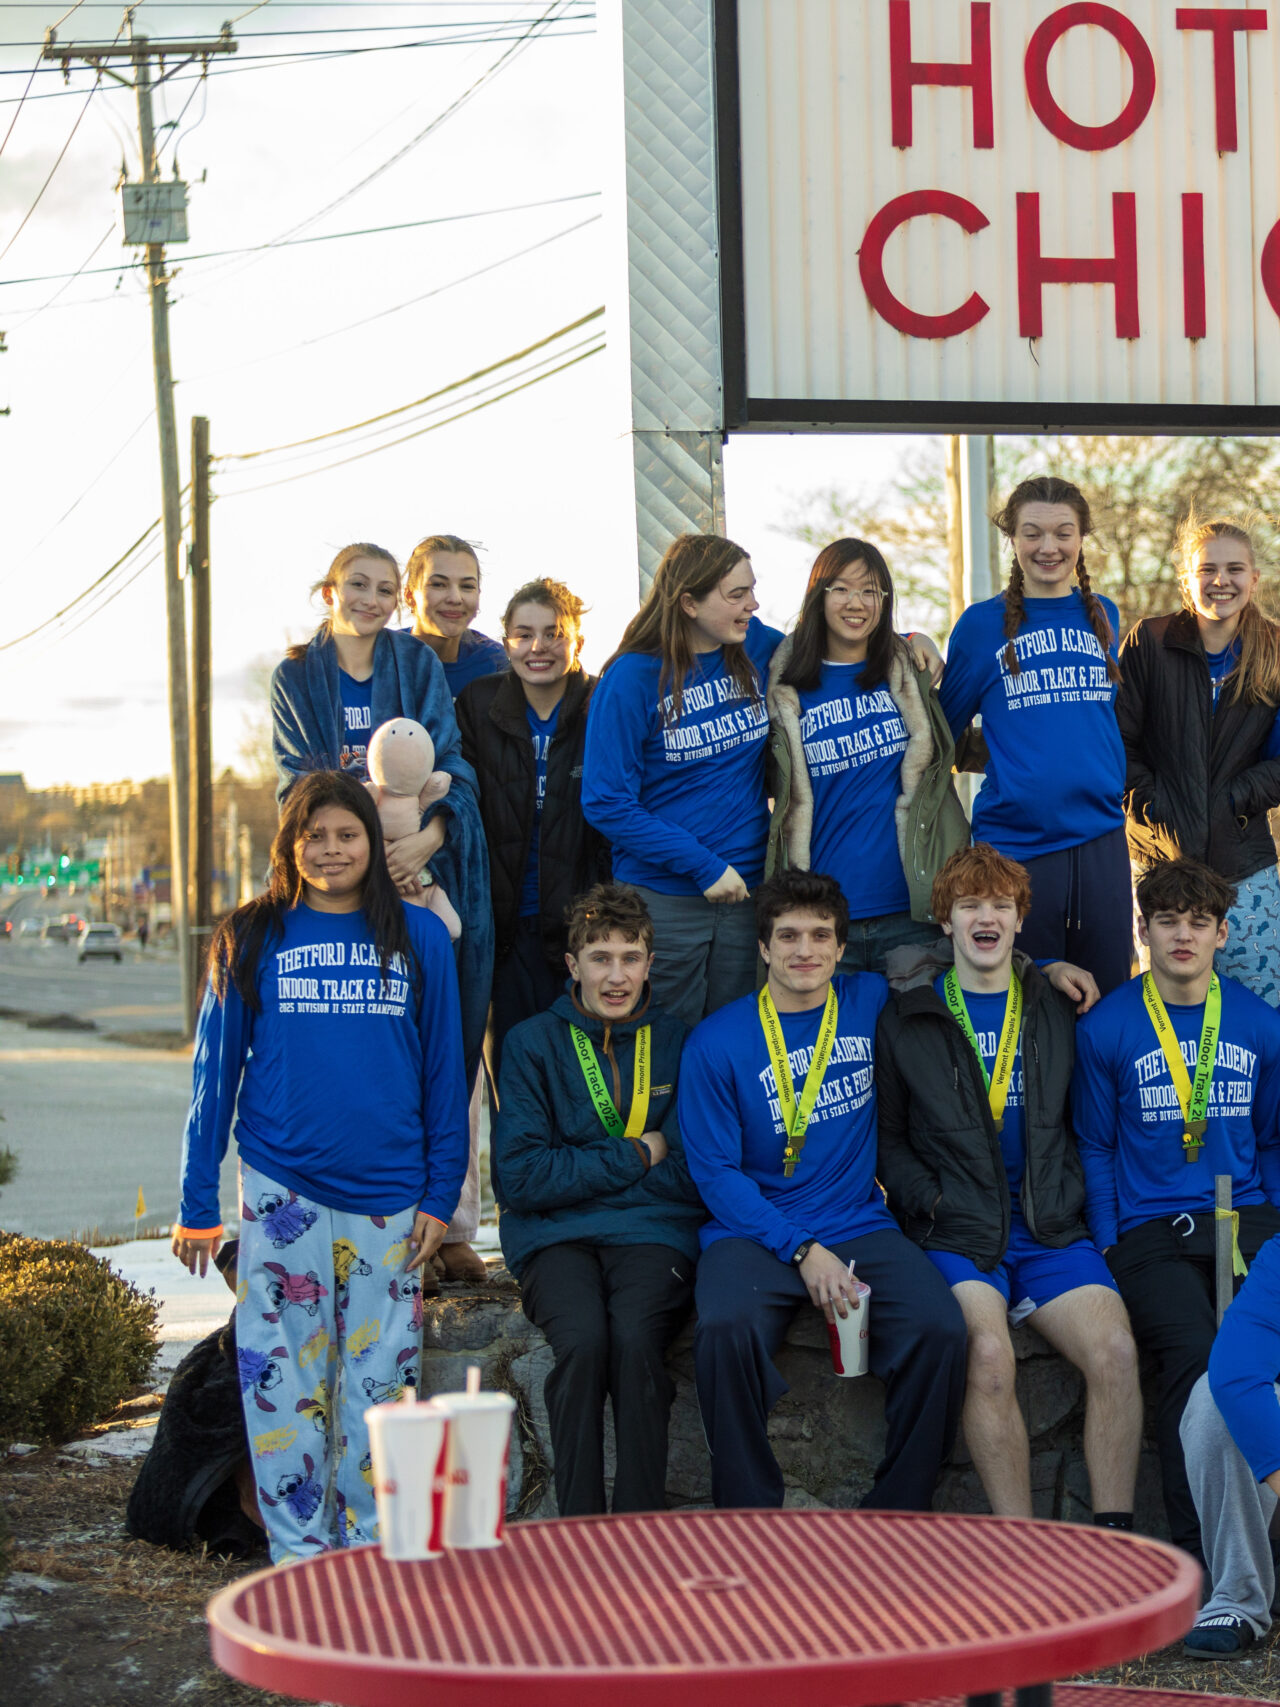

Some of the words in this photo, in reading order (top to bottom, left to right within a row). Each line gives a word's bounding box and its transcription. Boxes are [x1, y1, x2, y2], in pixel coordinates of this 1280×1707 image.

[889, 0, 1267, 151] HOT
[1040, 666, 1077, 690] TRACK
[1079, 666, 1087, 687] &
[1008, 699, 1021, 711] 2025
[1023, 692, 1051, 708] DIVISION
[1054, 692, 1060, 702] II
[1062, 691, 1081, 702] STATE
[1082, 690, 1113, 701] CHAMPIONS
[663, 725, 703, 751] INDOOR
[701, 714, 738, 744] TRACK
[734, 711, 747, 731] &
[801, 698, 853, 742] THETFORD
[665, 752, 681, 763] 2025
[684, 745, 713, 761] DIVISION
[715, 743, 721, 754] II
[722, 736, 741, 751] STATE
[804, 739, 840, 764] INDOOR
[837, 728, 875, 757] TRACK
[873, 724, 885, 746] &
[821, 759, 849, 776] DIVISION
[851, 757, 858, 768] II
[860, 750, 878, 765] STATE
[277, 943, 345, 975] THETFORD
[278, 978, 320, 1000] INDOOR
[322, 979, 363, 1000] TRACK
[366, 979, 376, 1000] &
[279, 1003, 295, 1013] 2025
[298, 1003, 329, 1013] DIVISION
[332, 1003, 339, 1013] II
[342, 1003, 365, 1014] STATE
[367, 1004, 406, 1016] CHAMPIONS
[1151, 1003, 1167, 1032] Vermont
[769, 1019, 783, 1057] Principals'
[777, 1059, 791, 1103] Association
[815, 1028, 832, 1071] Association
[996, 1055, 1008, 1085] Vermont
[1002, 1014, 1015, 1055] Principals'
[1200, 1026, 1216, 1068] Indoor
[586, 1063, 604, 1099] Track
[598, 1099, 619, 1128] 2025
[637, 1065, 645, 1095] Vermont
[843, 1076, 854, 1098] &
[852, 1064, 874, 1096] FIELD
[1139, 1084, 1181, 1109] INDOOR
[1218, 1081, 1225, 1103] &
[1227, 1081, 1252, 1104] FIELD
[1194, 1071, 1209, 1105] Track
[822, 1108, 828, 1120] II
[830, 1102, 849, 1117] STATE
[1142, 1111, 1157, 1122] 2025
[1220, 1106, 1251, 1117] CHAMPIONS
